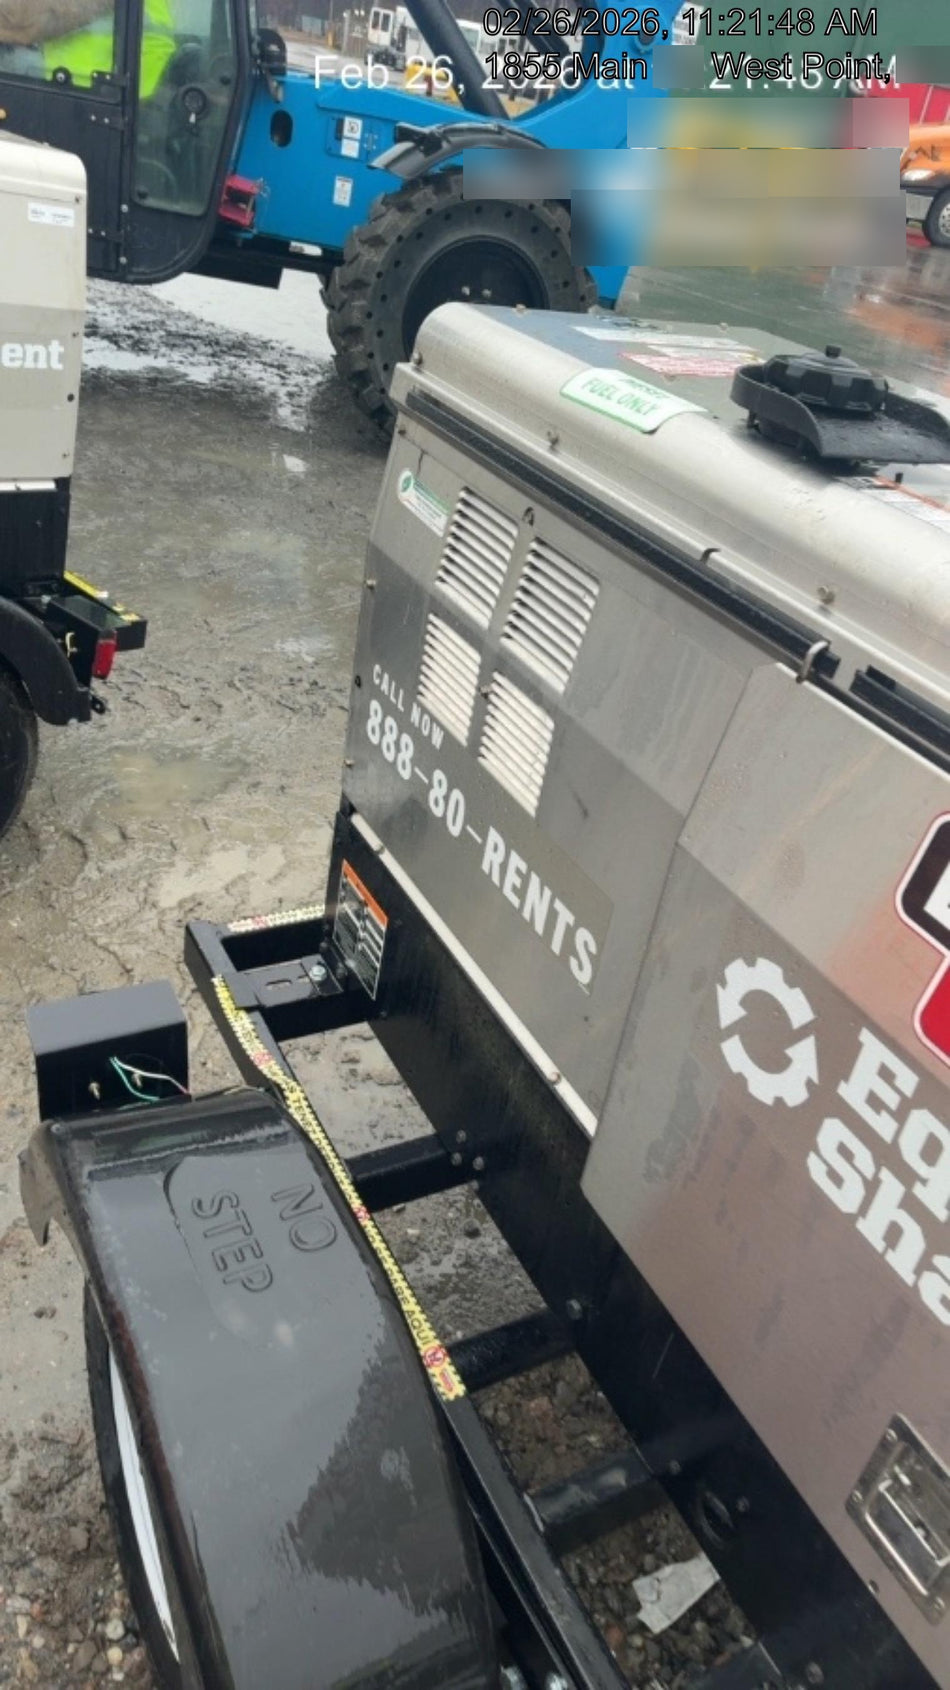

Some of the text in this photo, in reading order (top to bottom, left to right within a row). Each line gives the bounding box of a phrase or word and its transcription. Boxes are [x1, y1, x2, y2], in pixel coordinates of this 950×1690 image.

[1, 340, 64, 370] ent
[617, 393, 661, 415] ONLY
[373, 664, 444, 750] CALL NOW
[366, 700, 597, 985] 888-80-RENTS
[192, 1189, 273, 1292] STEP
[271, 1183, 338, 1253] NO
